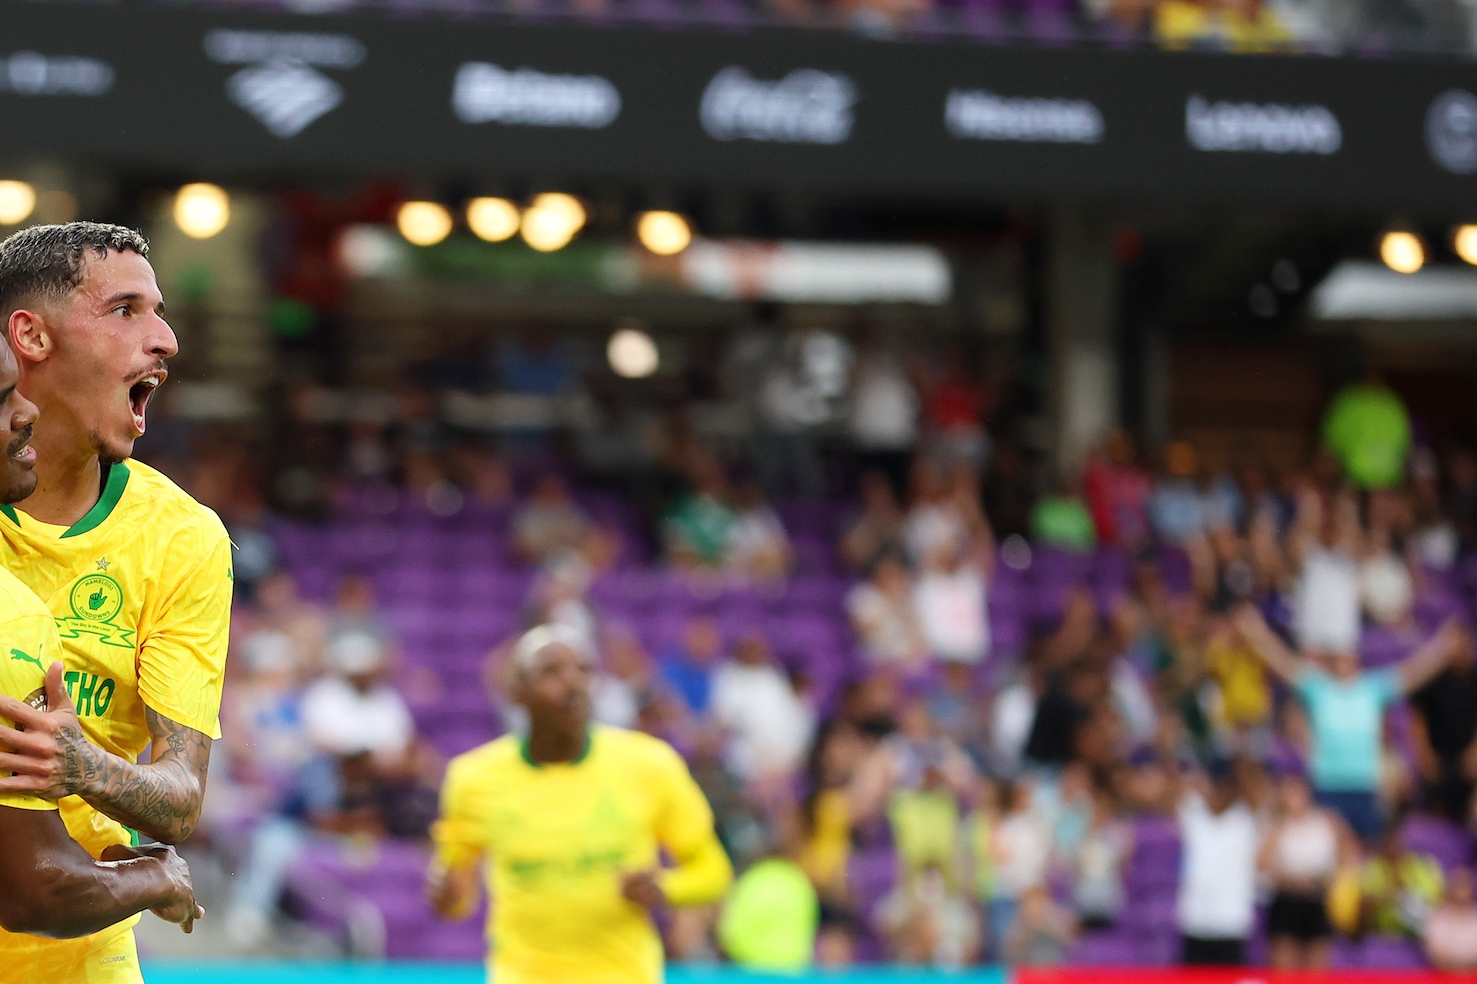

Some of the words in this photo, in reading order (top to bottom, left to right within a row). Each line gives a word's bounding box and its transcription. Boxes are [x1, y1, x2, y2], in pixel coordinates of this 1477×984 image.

[85, 579, 114, 591] MAMELODI
[79, 606, 110, 619] SUNDOWNS
[64, 671, 116, 717] THO
